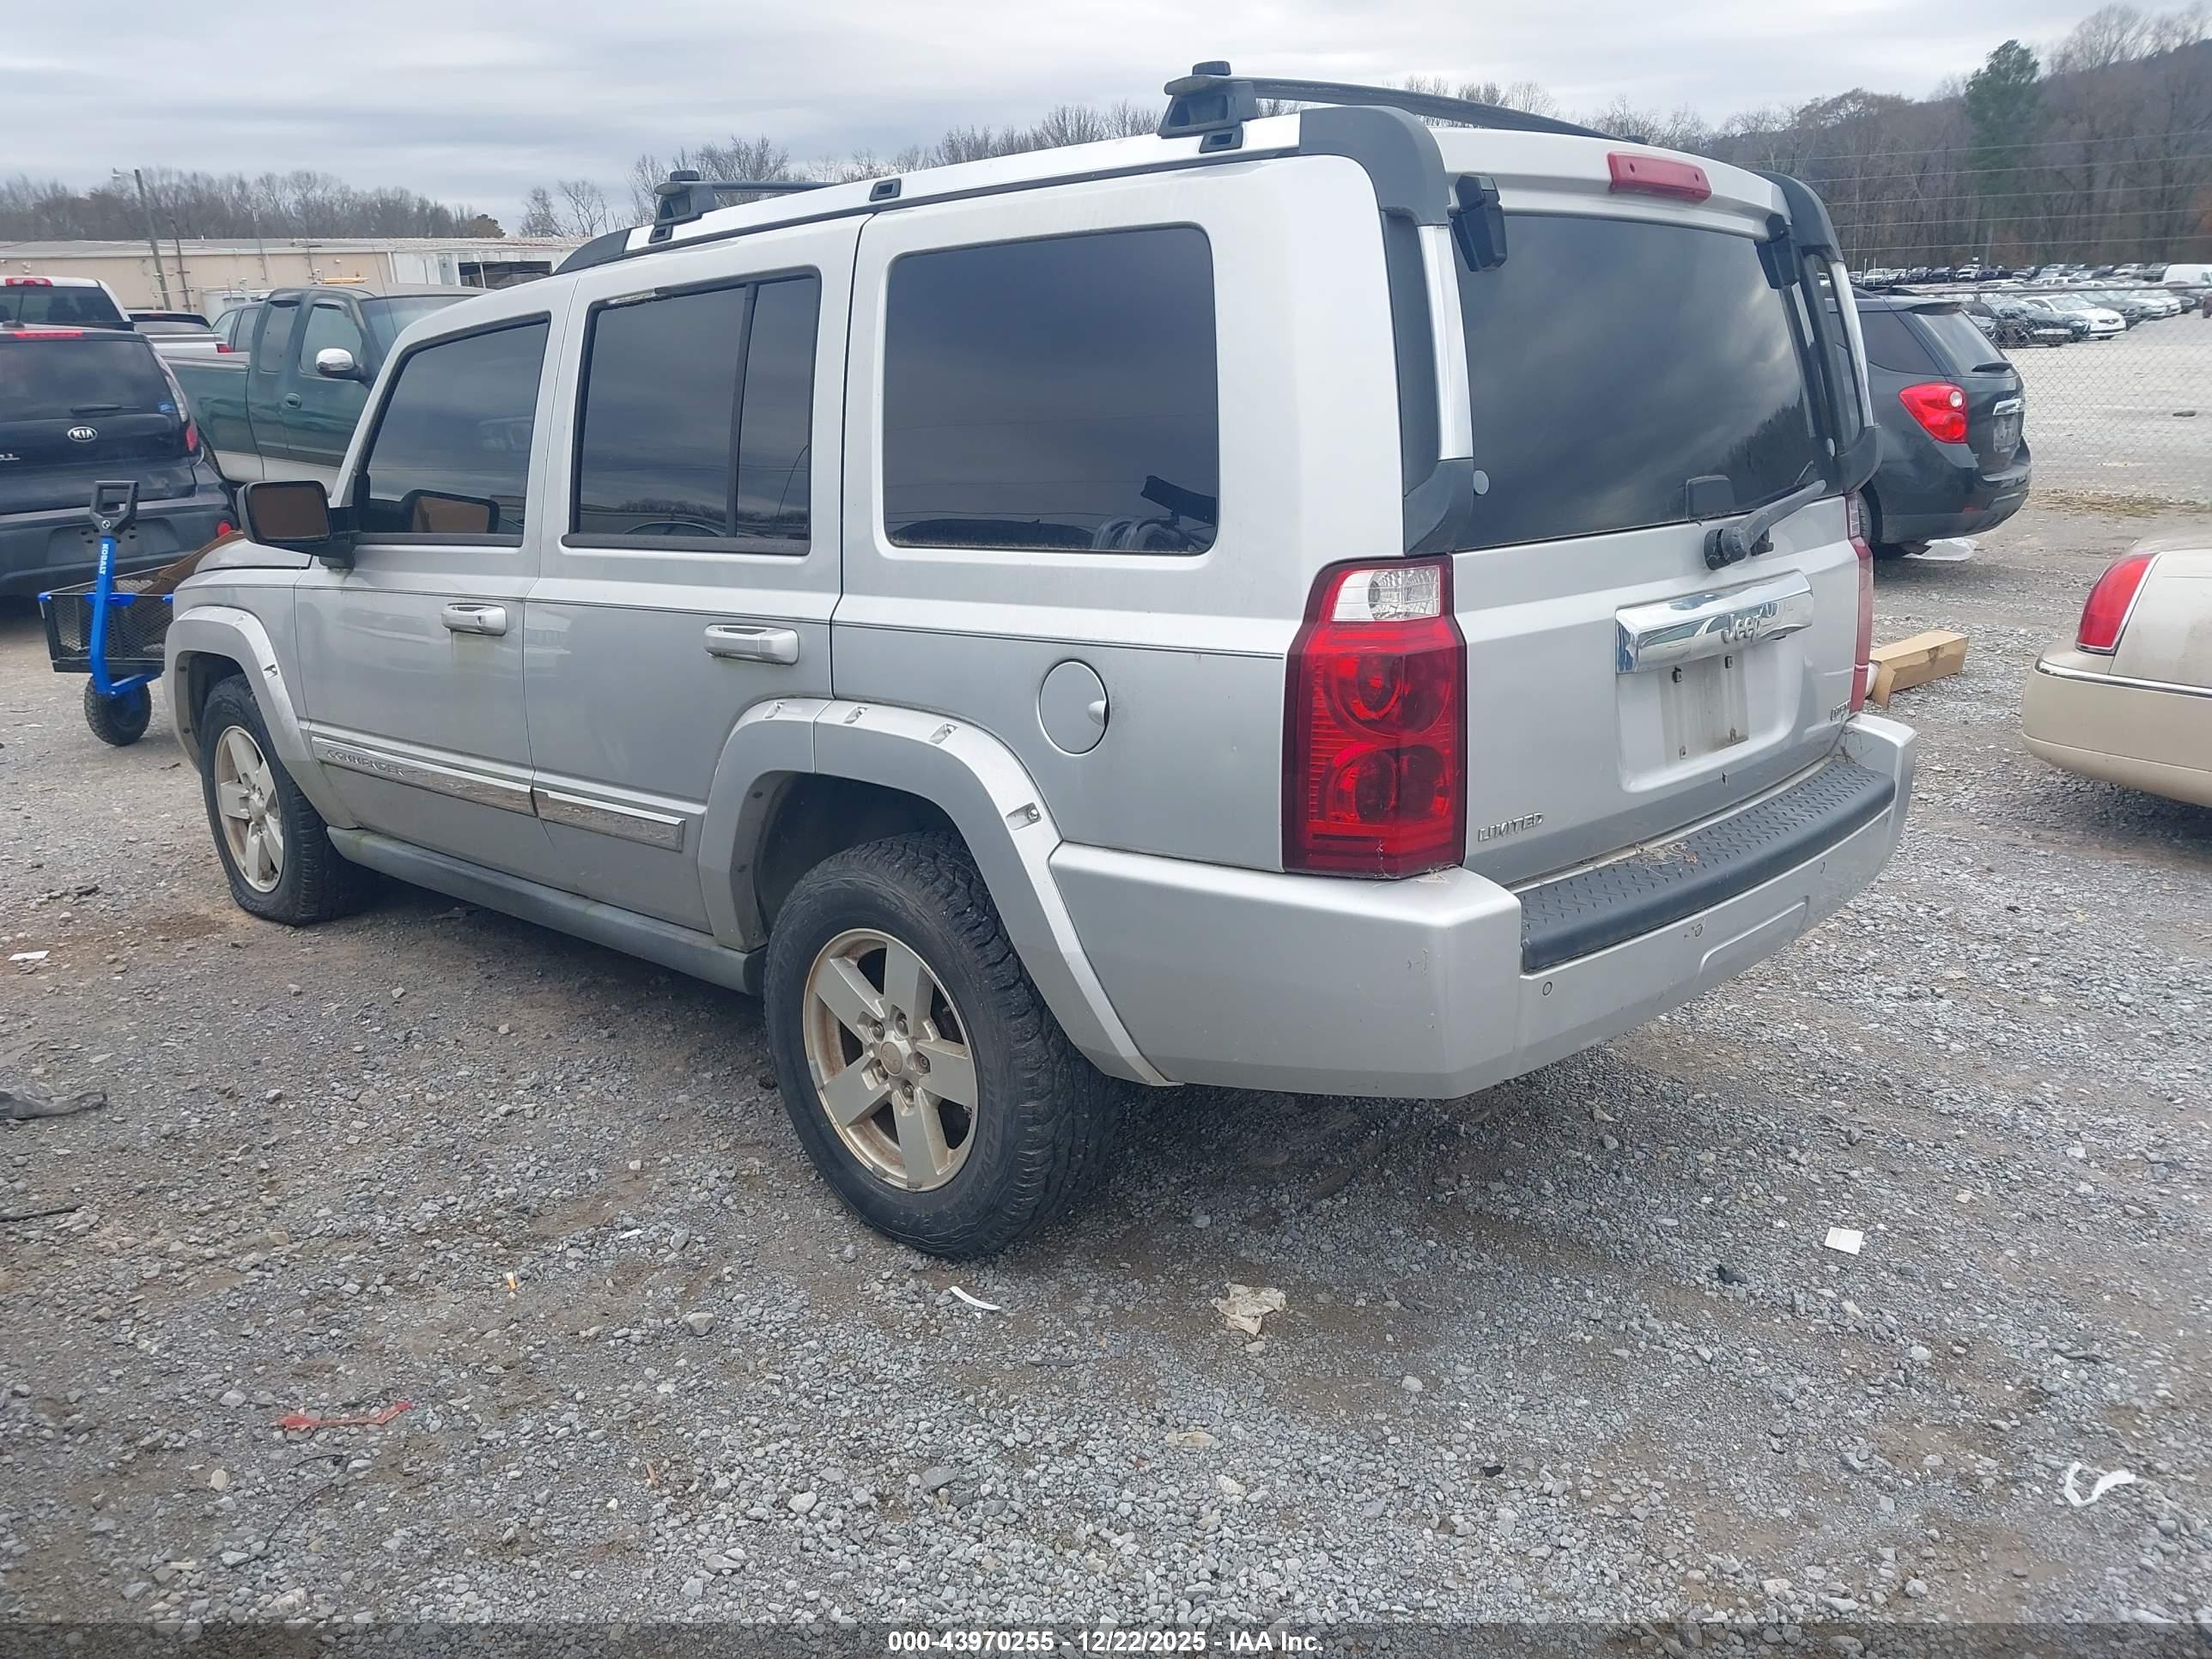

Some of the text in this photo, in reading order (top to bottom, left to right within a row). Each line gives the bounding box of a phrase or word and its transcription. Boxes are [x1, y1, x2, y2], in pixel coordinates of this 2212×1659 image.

[99, 543, 109, 575] KOBALT
[1721, 613, 1761, 644] Jeep
[1477, 812, 1544, 842] LIMITED
